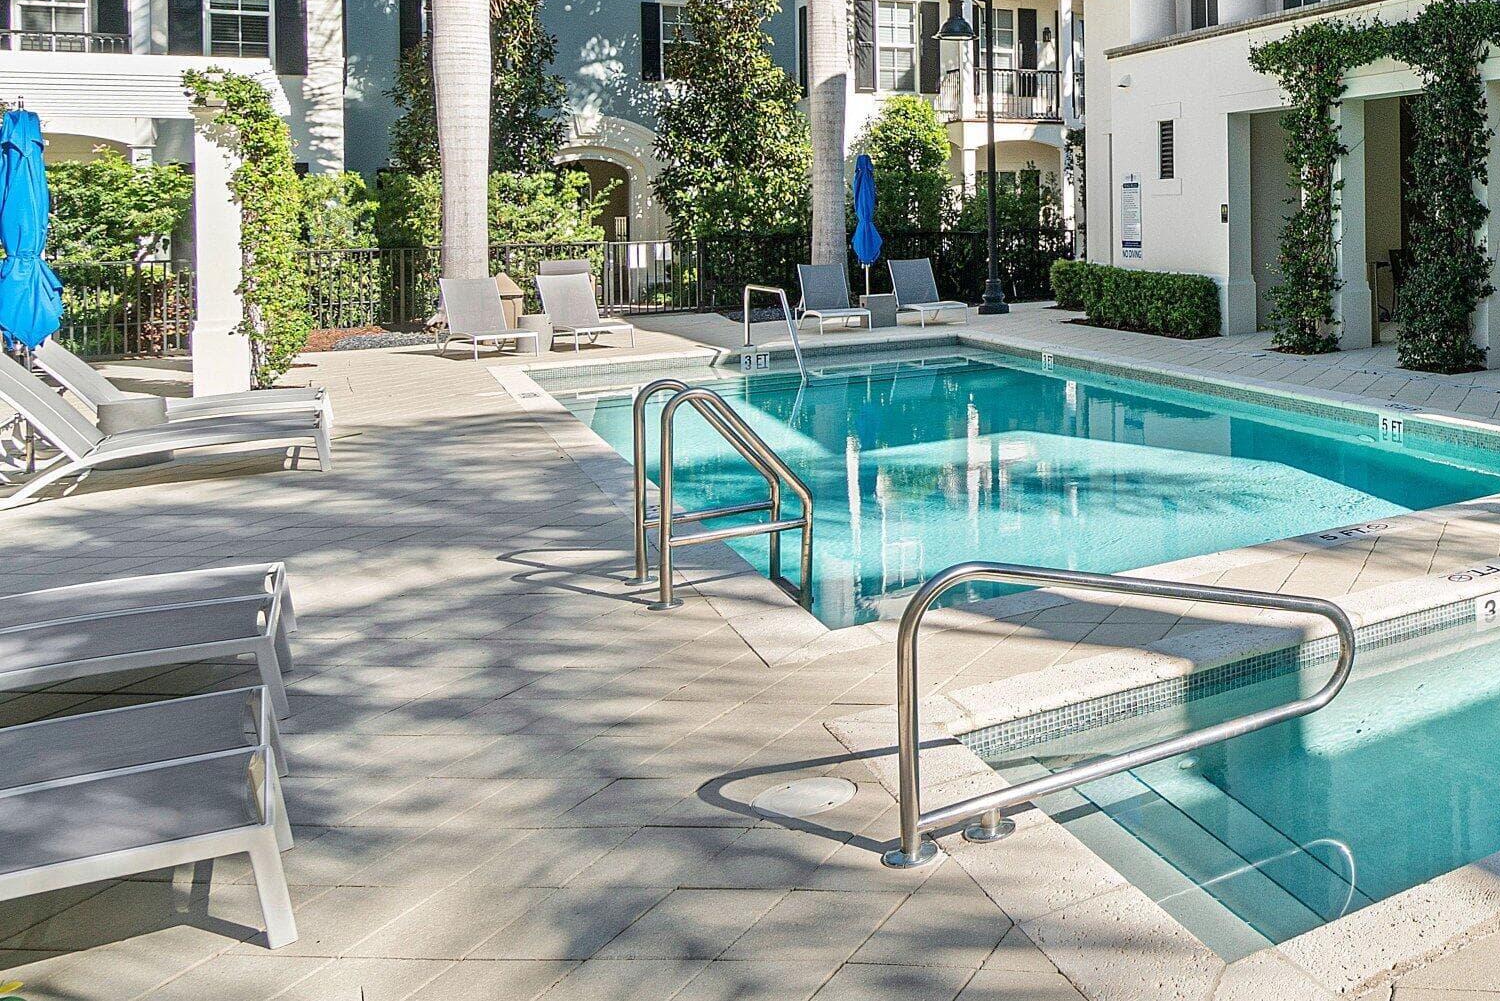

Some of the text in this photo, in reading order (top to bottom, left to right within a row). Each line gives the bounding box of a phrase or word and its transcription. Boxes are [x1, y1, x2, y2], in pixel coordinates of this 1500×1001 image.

[1122, 250, 1128, 258] NO
[756, 353, 768, 365] FT
[1382, 418, 1403, 432] 5 FT
[1484, 599, 1496, 618] 3
